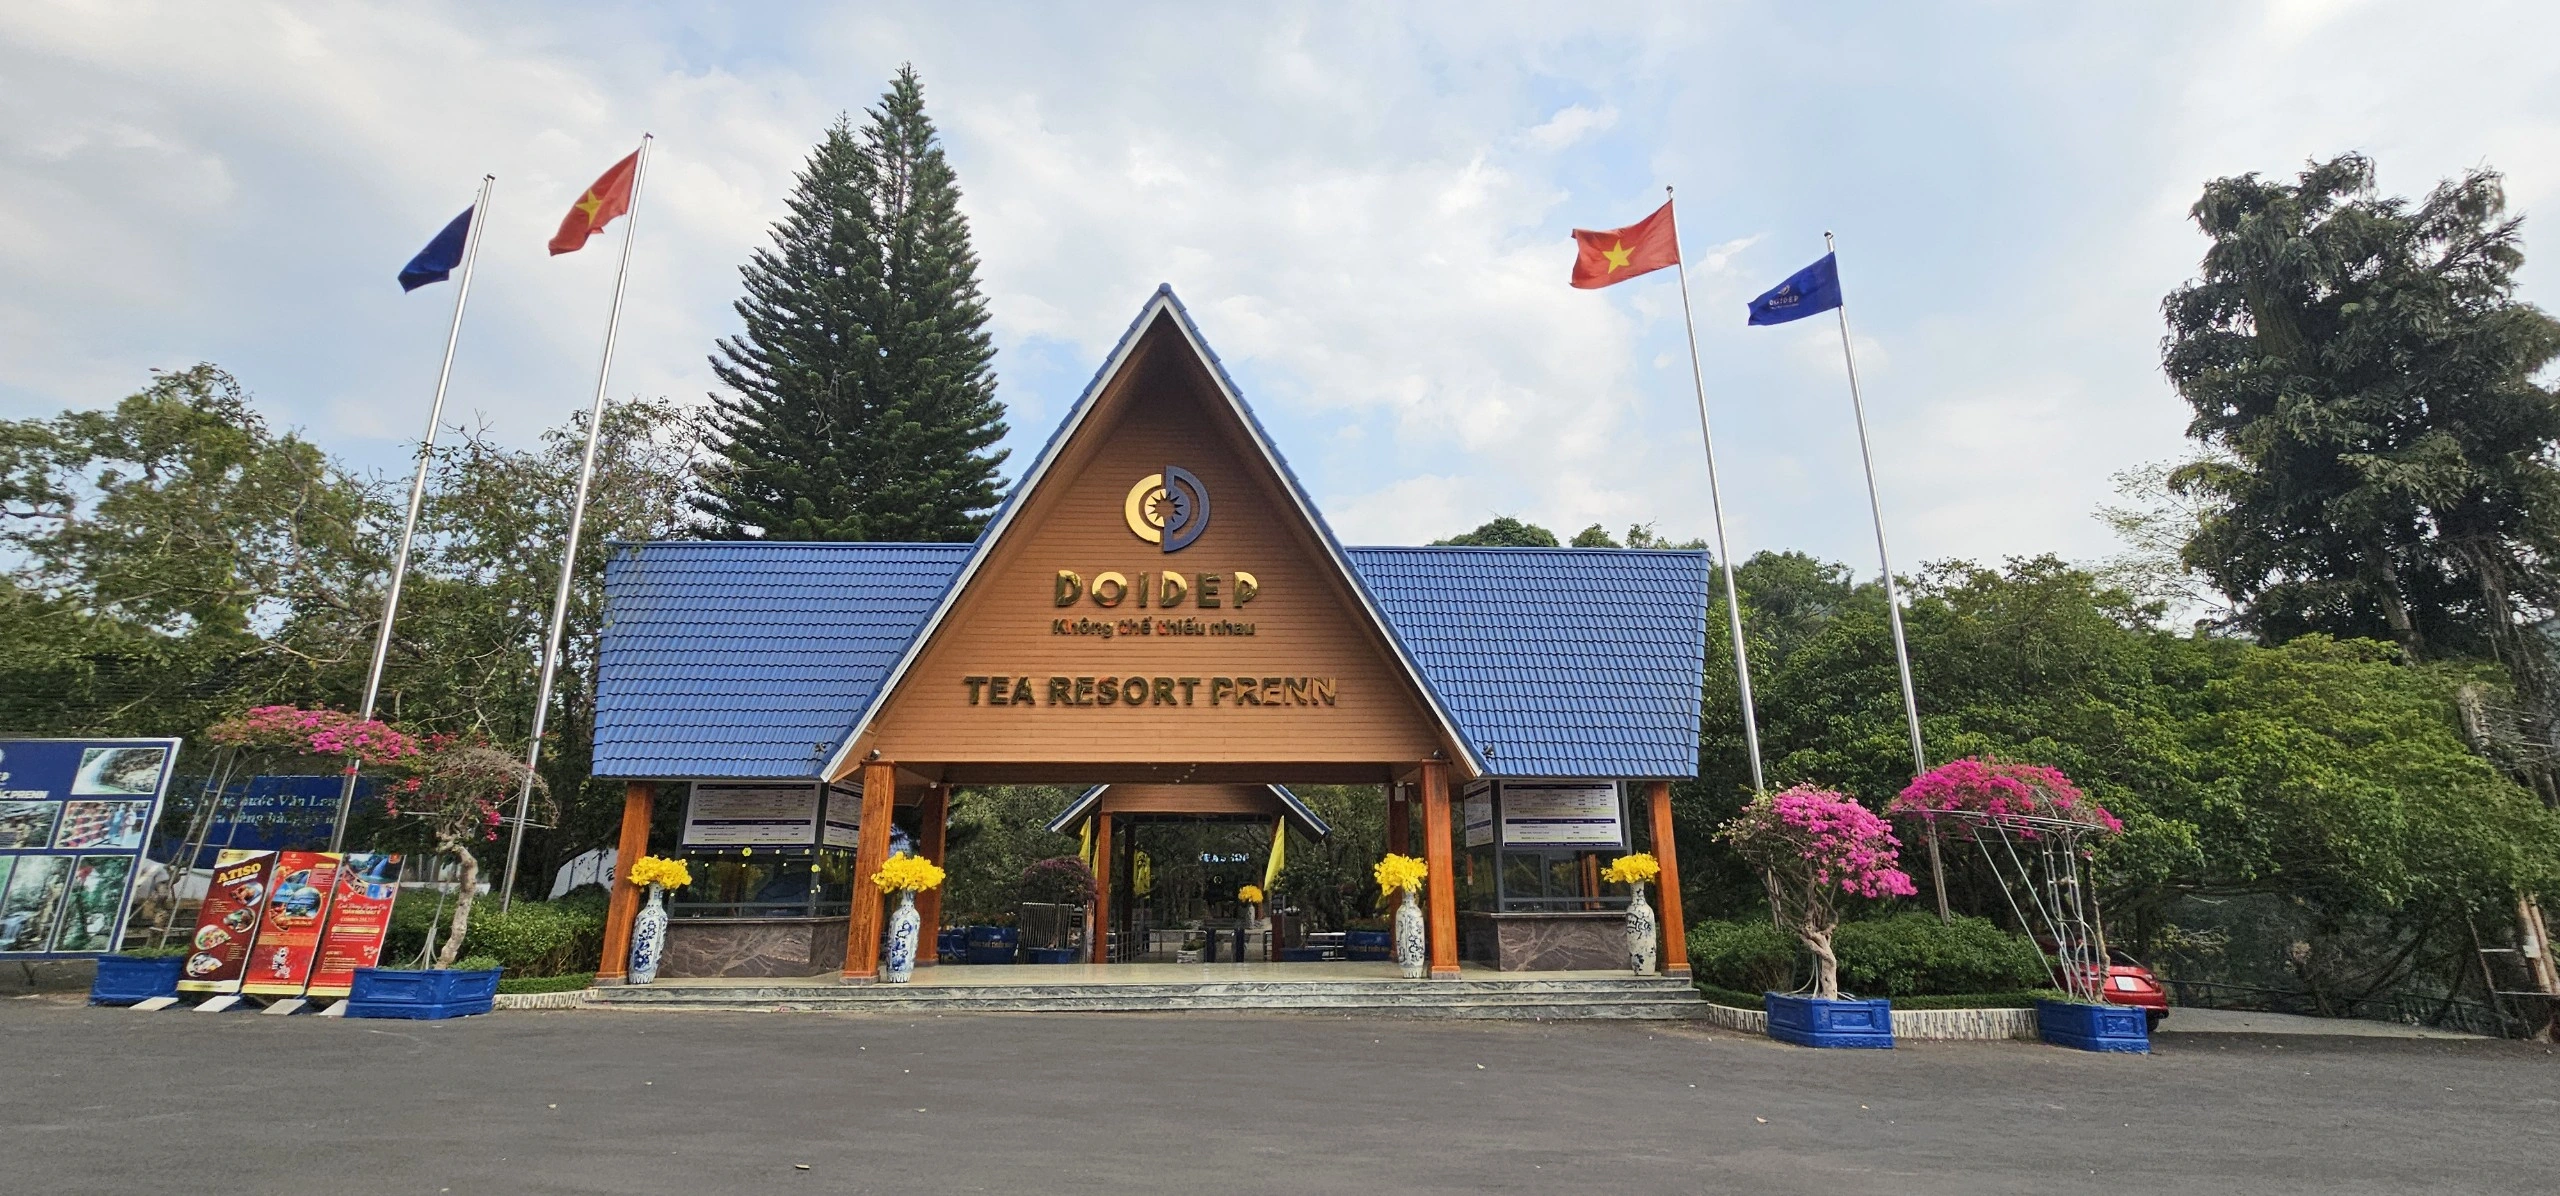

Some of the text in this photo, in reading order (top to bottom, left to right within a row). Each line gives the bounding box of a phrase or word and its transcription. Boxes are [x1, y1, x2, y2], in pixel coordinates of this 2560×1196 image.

[1055, 569, 1259, 608] DOIDEP
[1052, 616, 1256, 638] Không thế thiếu nhau
[963, 676, 1336, 706] TEA RESORT PRENN
[217, 863, 262, 884] ATISO
